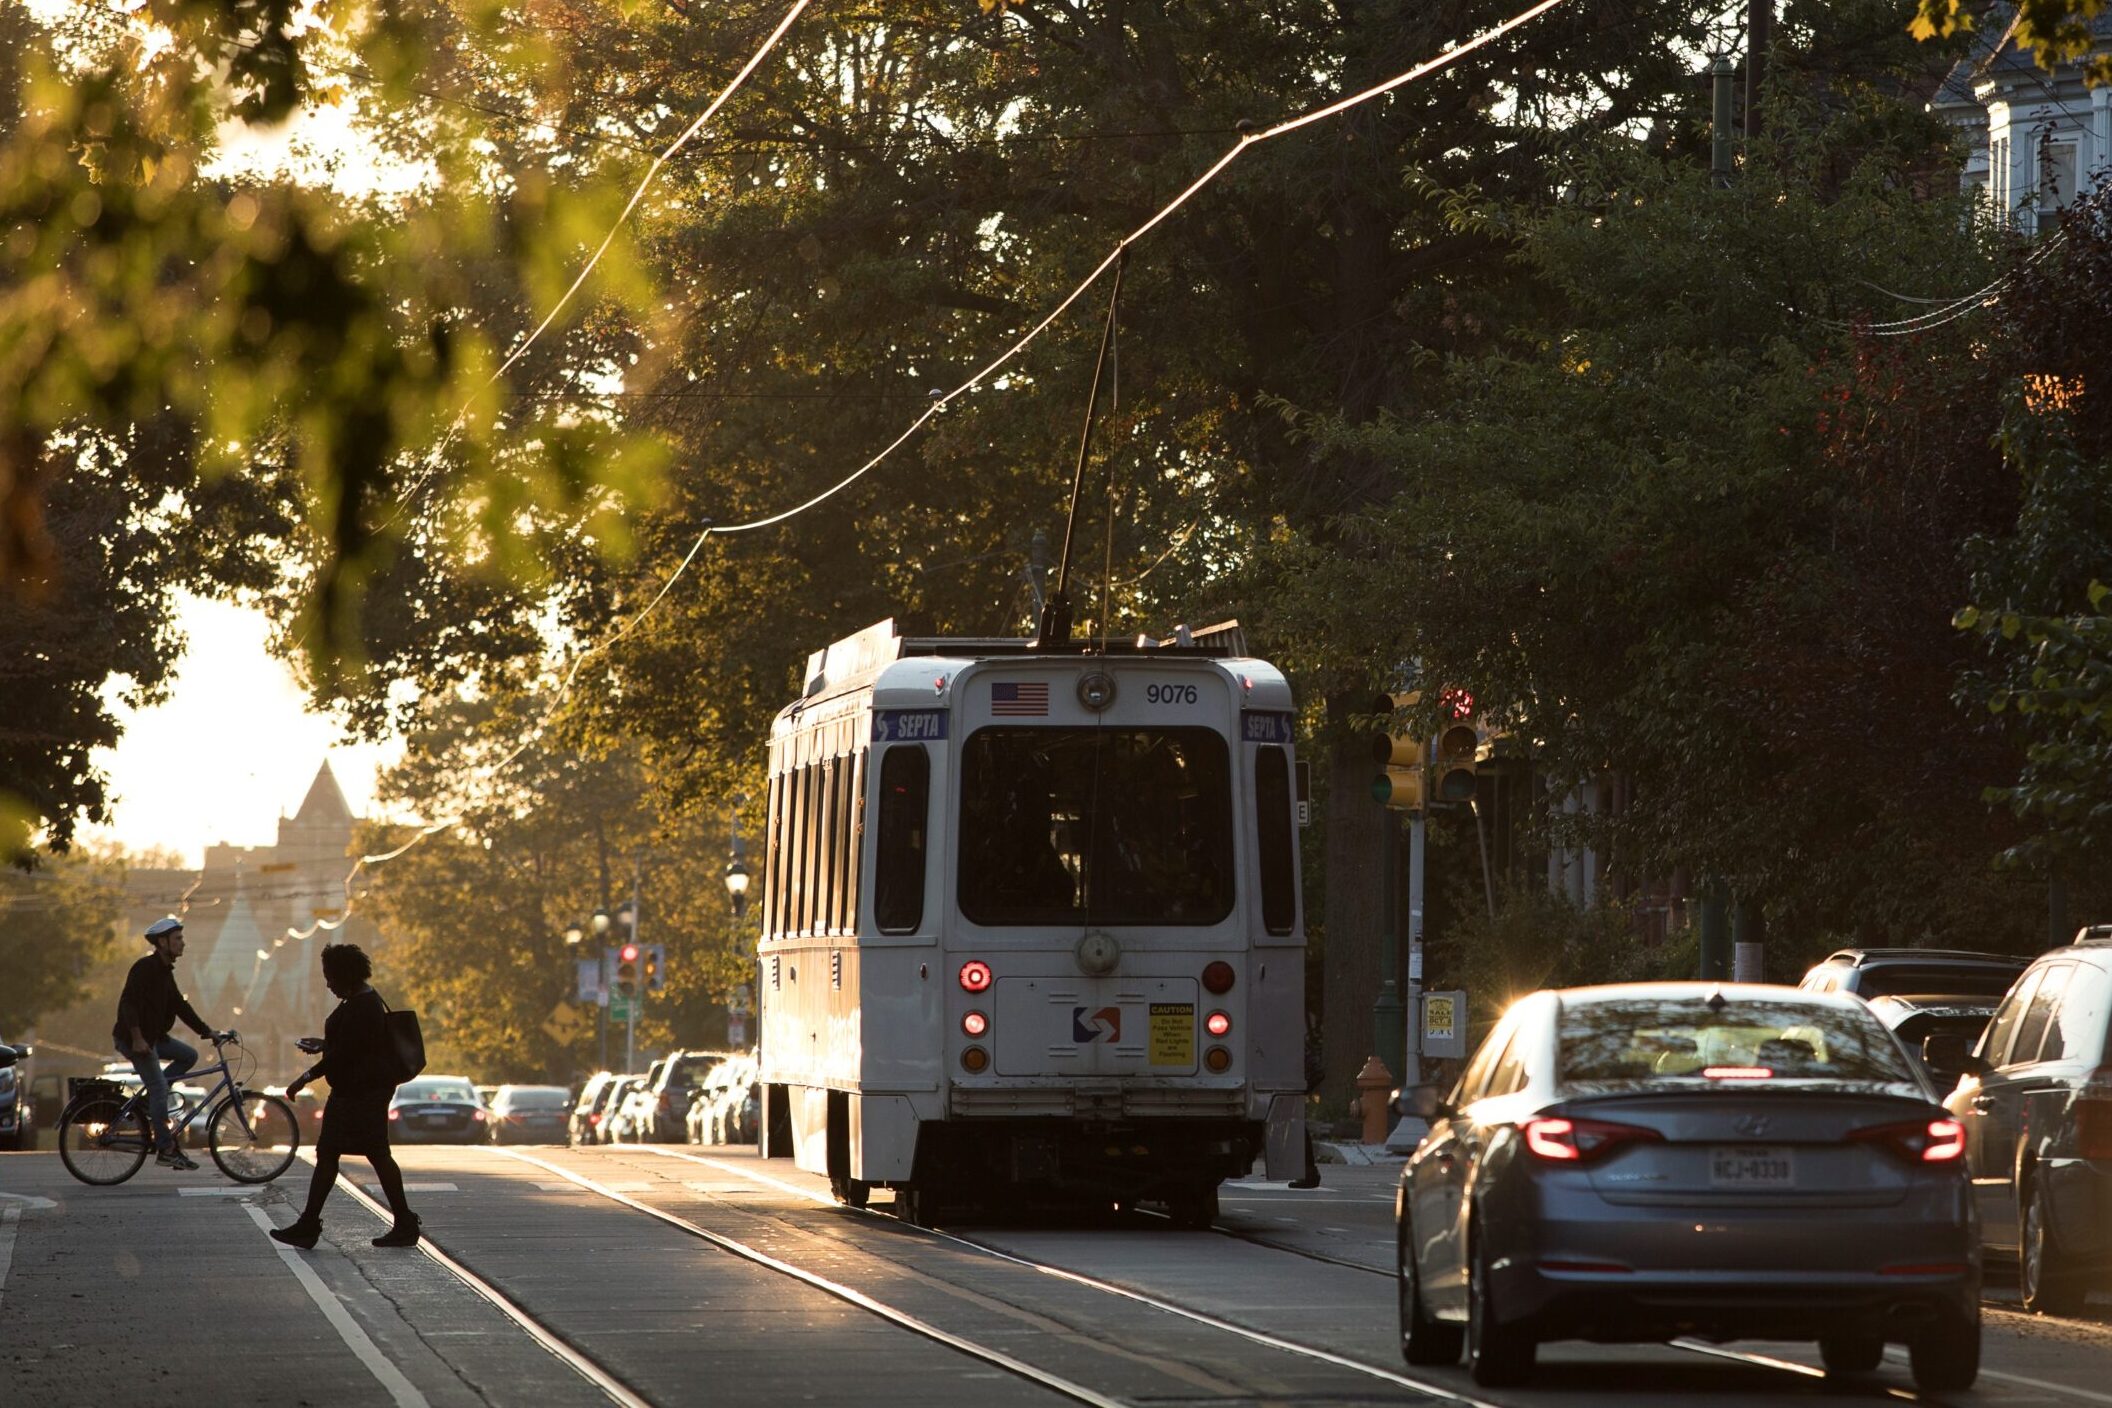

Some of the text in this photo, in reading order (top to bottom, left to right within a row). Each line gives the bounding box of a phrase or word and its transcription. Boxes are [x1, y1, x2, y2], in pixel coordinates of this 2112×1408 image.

[1147, 684, 1198, 704] 9076
[898, 714, 939, 738] SEPTA
[1248, 715, 1277, 739] SEPTA
[1151, 1006, 1193, 1014] CAUTION
